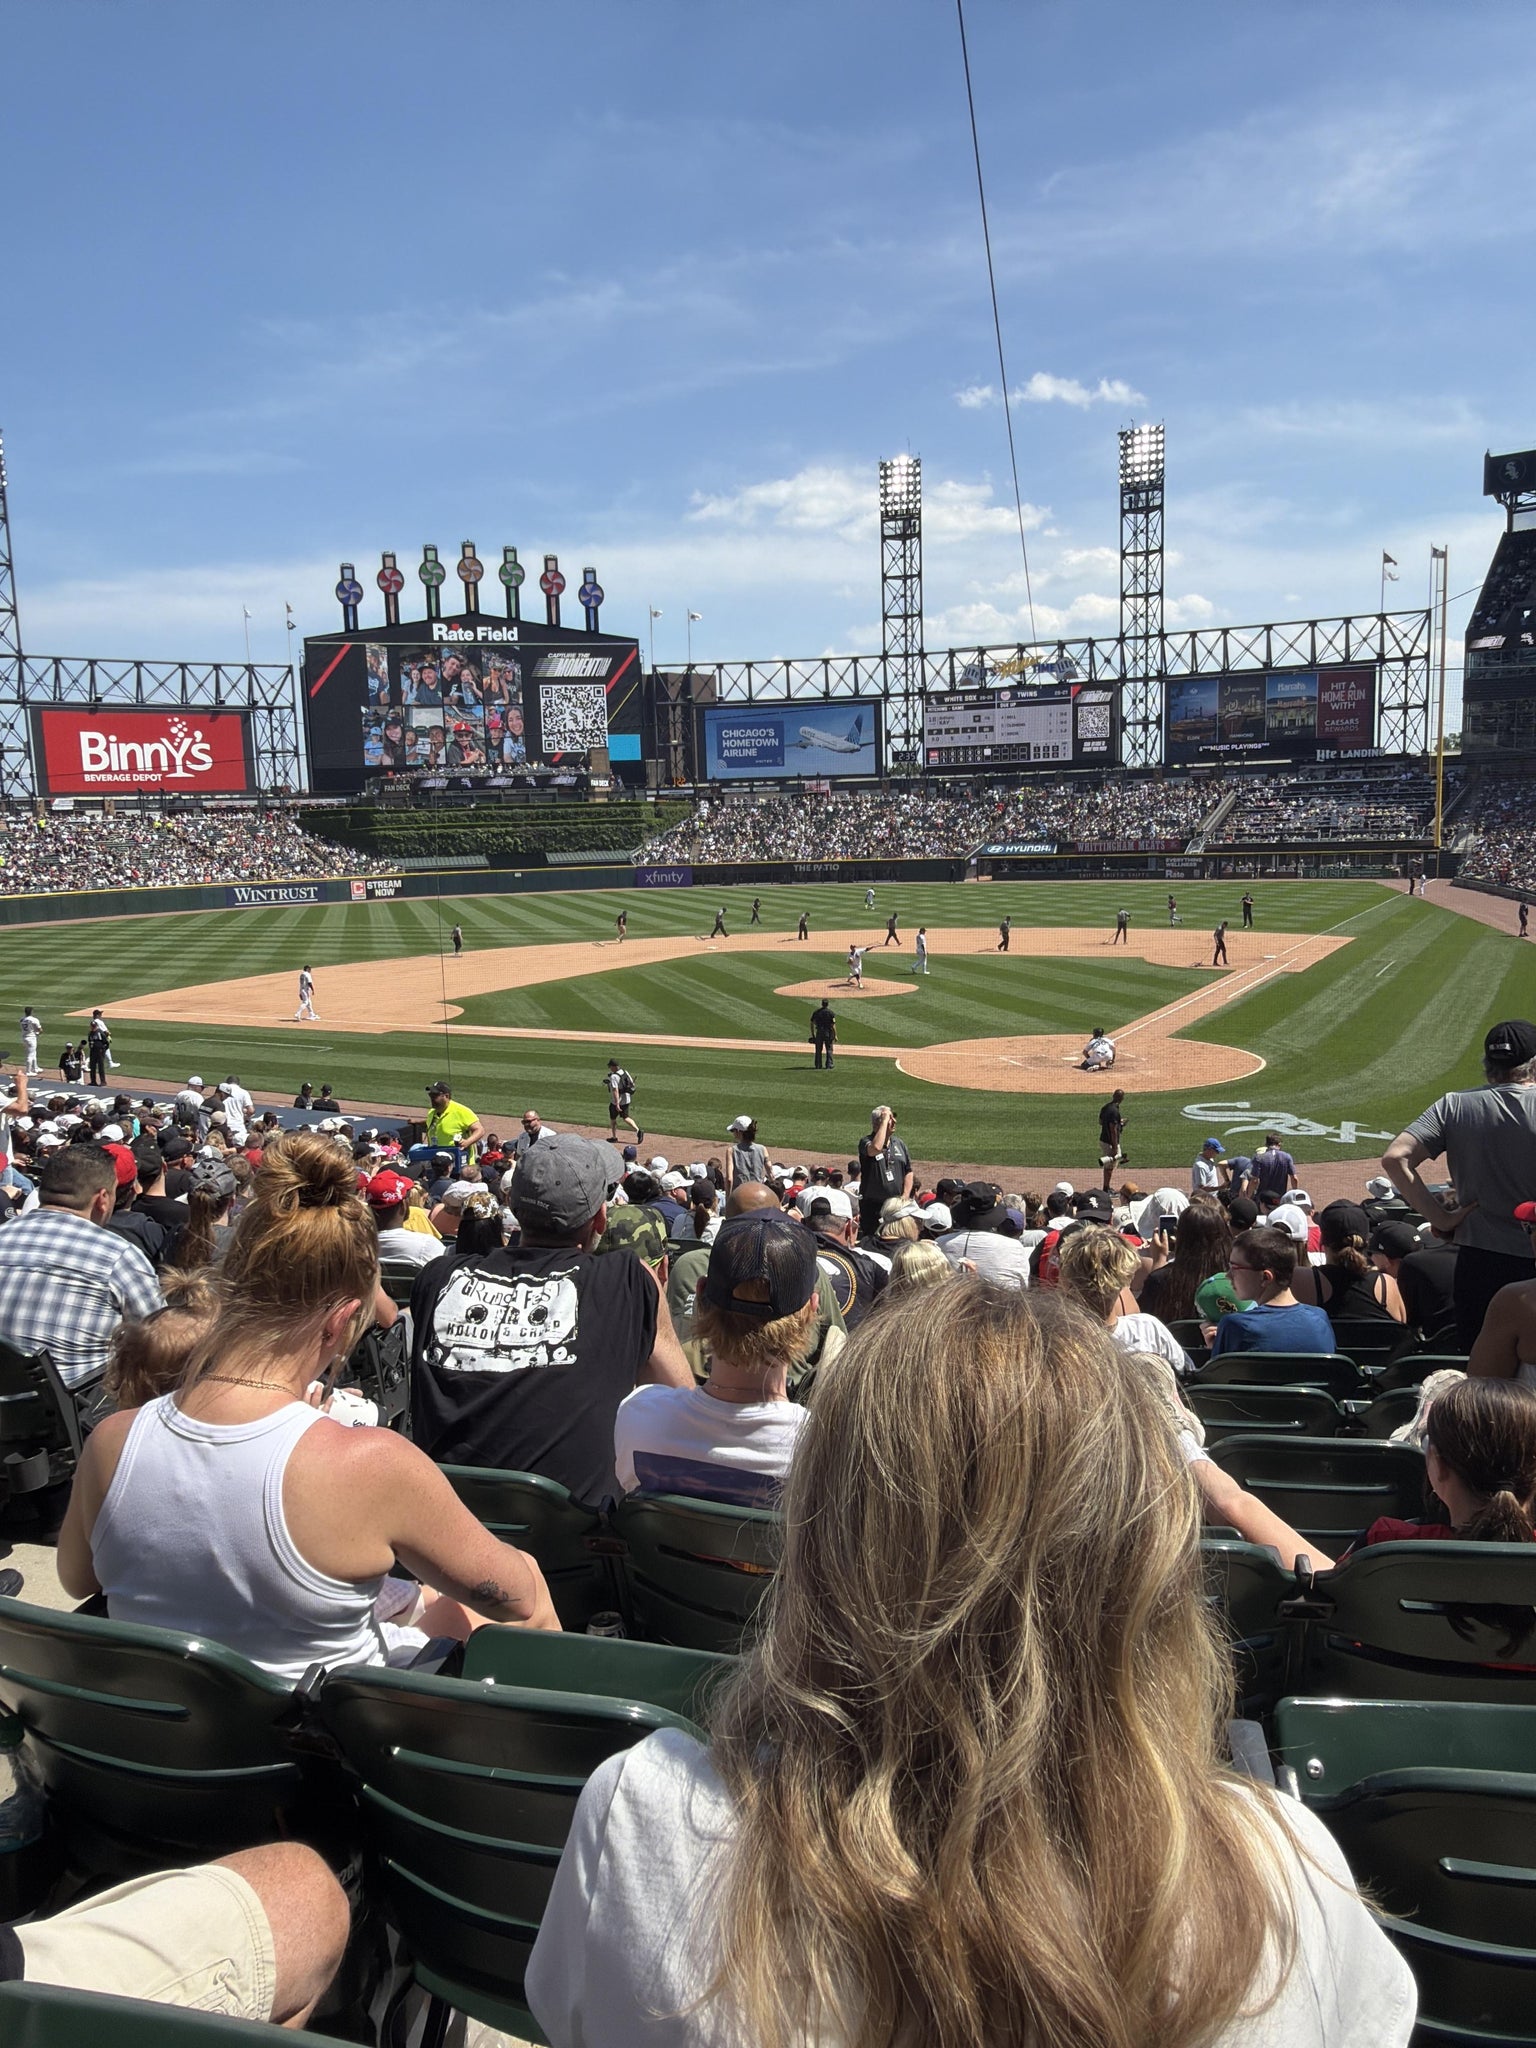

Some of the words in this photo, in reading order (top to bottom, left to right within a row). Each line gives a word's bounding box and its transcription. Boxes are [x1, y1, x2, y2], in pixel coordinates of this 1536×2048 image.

[432, 623, 474, 641] Rate
[476, 627, 518, 641] Field
[1331, 681, 1347, 691] HIT
[1349, 681, 1357, 690] A
[1017, 690, 1038, 698] TWINS
[1321, 690, 1346, 703] HOME
[1347, 689, 1366, 702] RUN
[1330, 701, 1356, 711] WITH
[1324, 718, 1360, 726] CAESARS
[722, 728, 775, 738] CHICAGO'S
[722, 738, 778, 748] HOMETOWN
[722, 748, 757, 758] AIRLINE
[898, 752, 916, 761] 2:35
[1316, 748, 1338, 762] Lite
[1340, 748, 1385, 759] LANDING
[84, 773, 132, 782] BEVERAGE
[133, 773, 163, 781] DEPOT
[384, 784, 397, 793] FAN
[397, 783, 411, 791] DECK
[1138, 840, 1166, 851] MEATS
[793, 863, 812, 873] THE
[644, 871, 684, 886] xfinity
[1165, 869, 1185, 879] Rate
[367, 880, 402, 890] STREAM
[234, 887, 318, 902] WINTRUST
[375, 888, 395, 897] NOW
